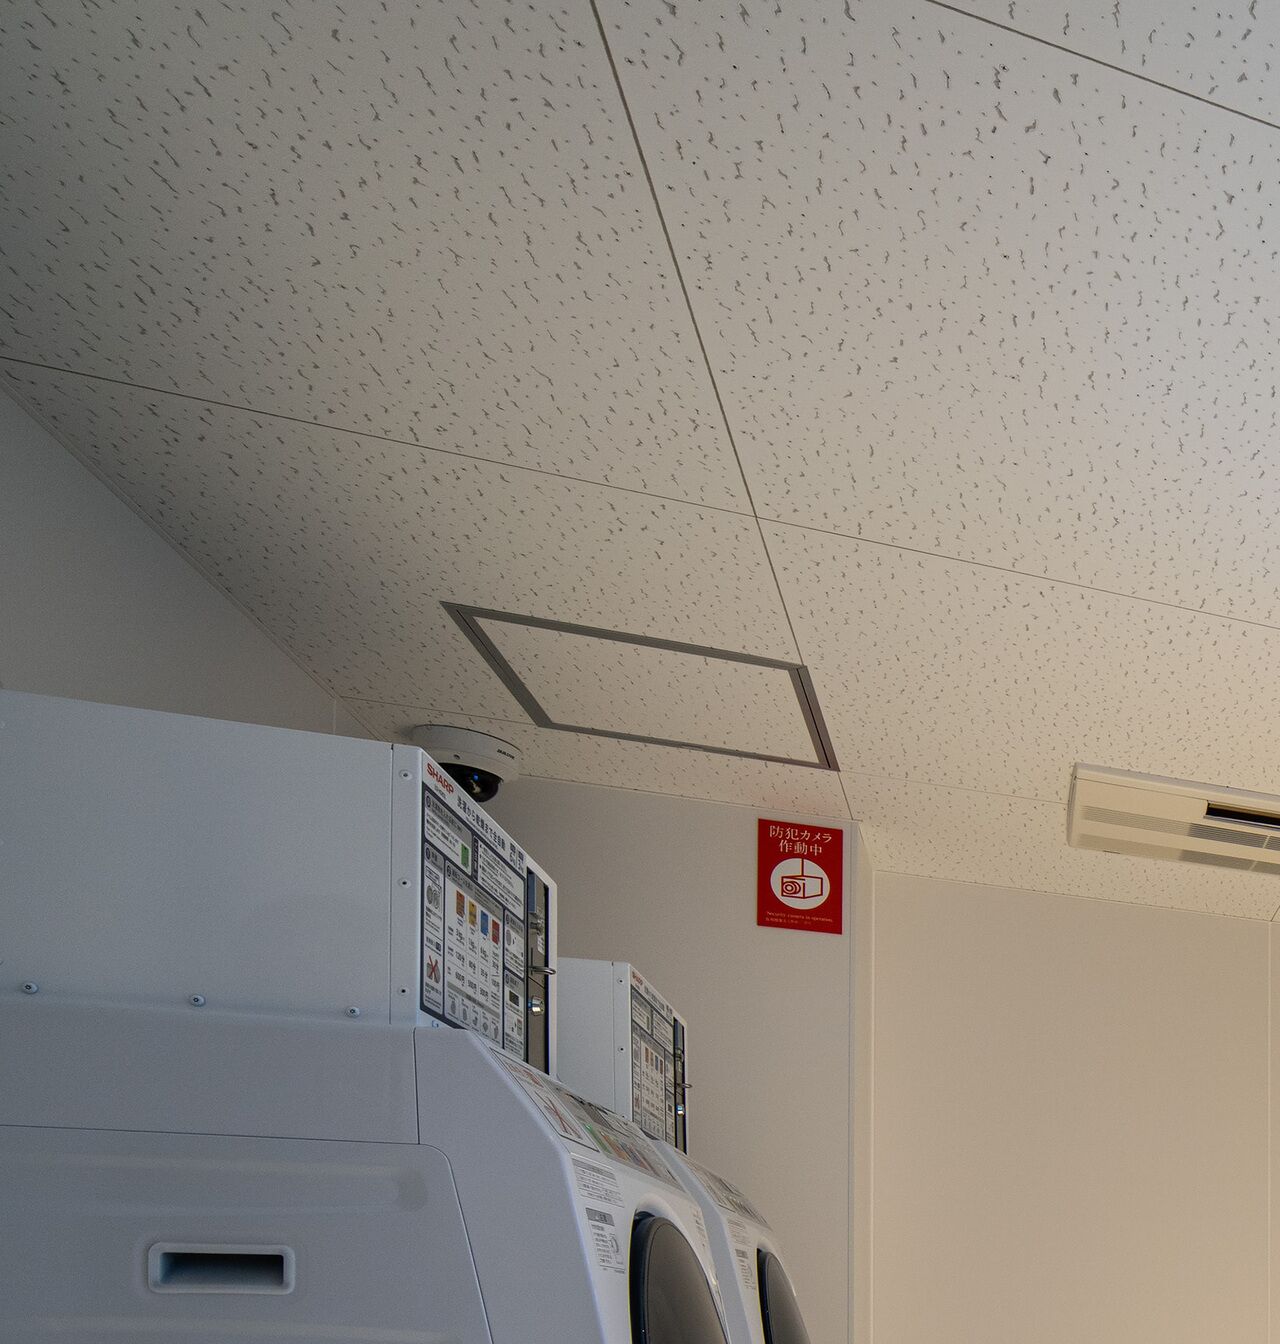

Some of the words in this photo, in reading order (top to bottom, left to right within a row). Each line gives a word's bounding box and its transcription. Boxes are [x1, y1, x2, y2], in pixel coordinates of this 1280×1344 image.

[426, 762, 455, 794] SHARP
[768, 824, 833, 844] 防犯カメラ
[778, 839, 823, 857] 作動中
